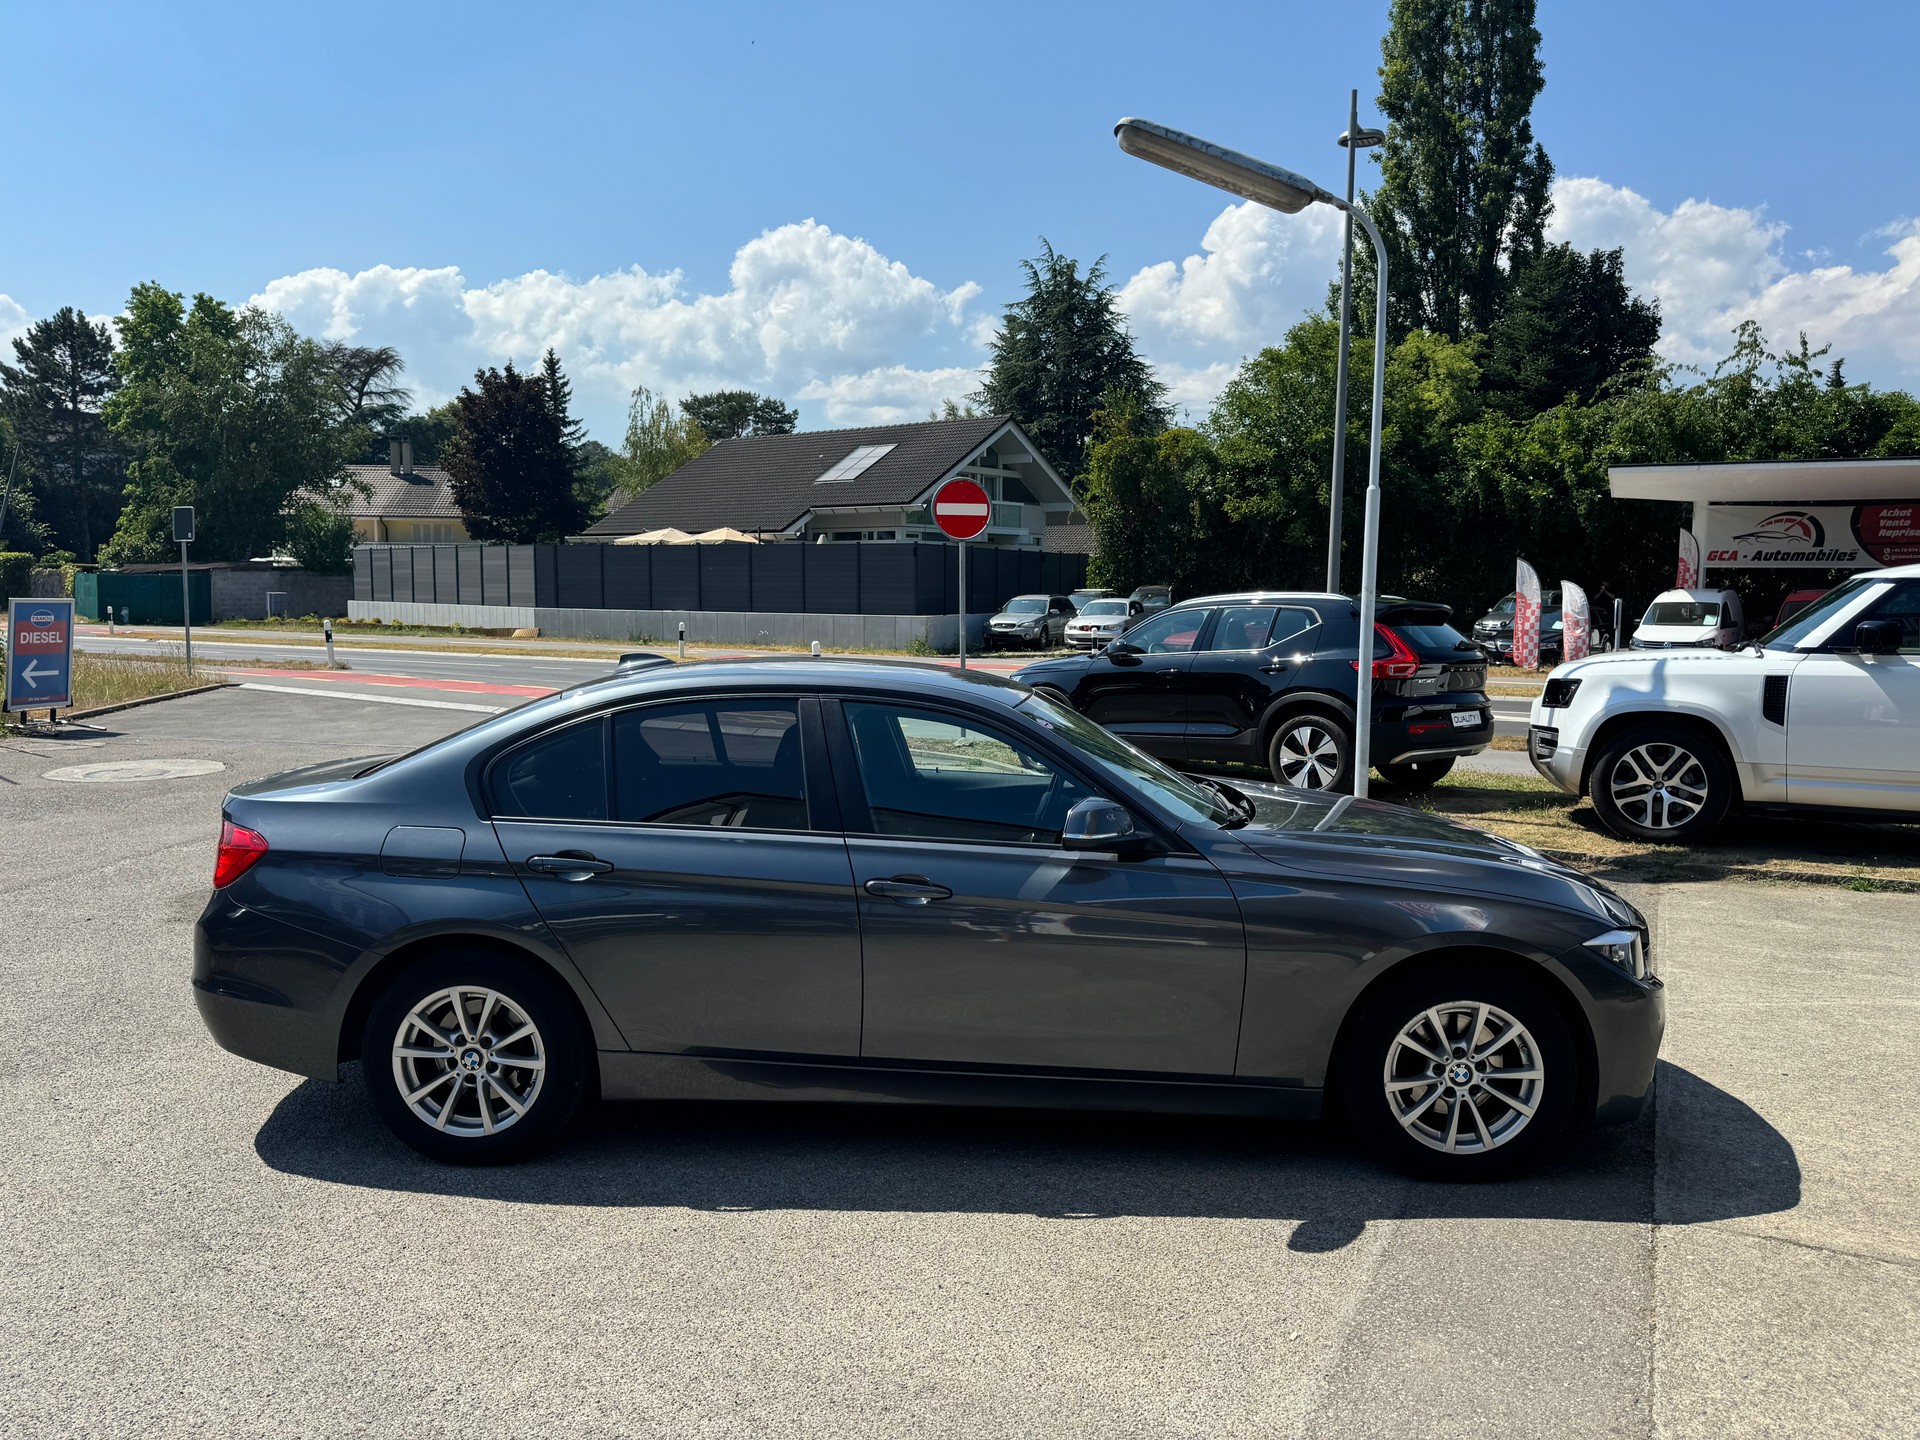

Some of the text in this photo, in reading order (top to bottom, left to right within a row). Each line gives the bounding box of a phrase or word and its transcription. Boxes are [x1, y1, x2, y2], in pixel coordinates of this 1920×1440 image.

[1879, 508, 1912, 517] Achat
[1878, 528, 1920, 538] Reprise
[1706, 550, 1738, 561] GCA
[1751, 549, 1857, 561] Automobiles
[20, 632, 63, 644] DIESEL
[1454, 714, 1476, 723] QUALITY
